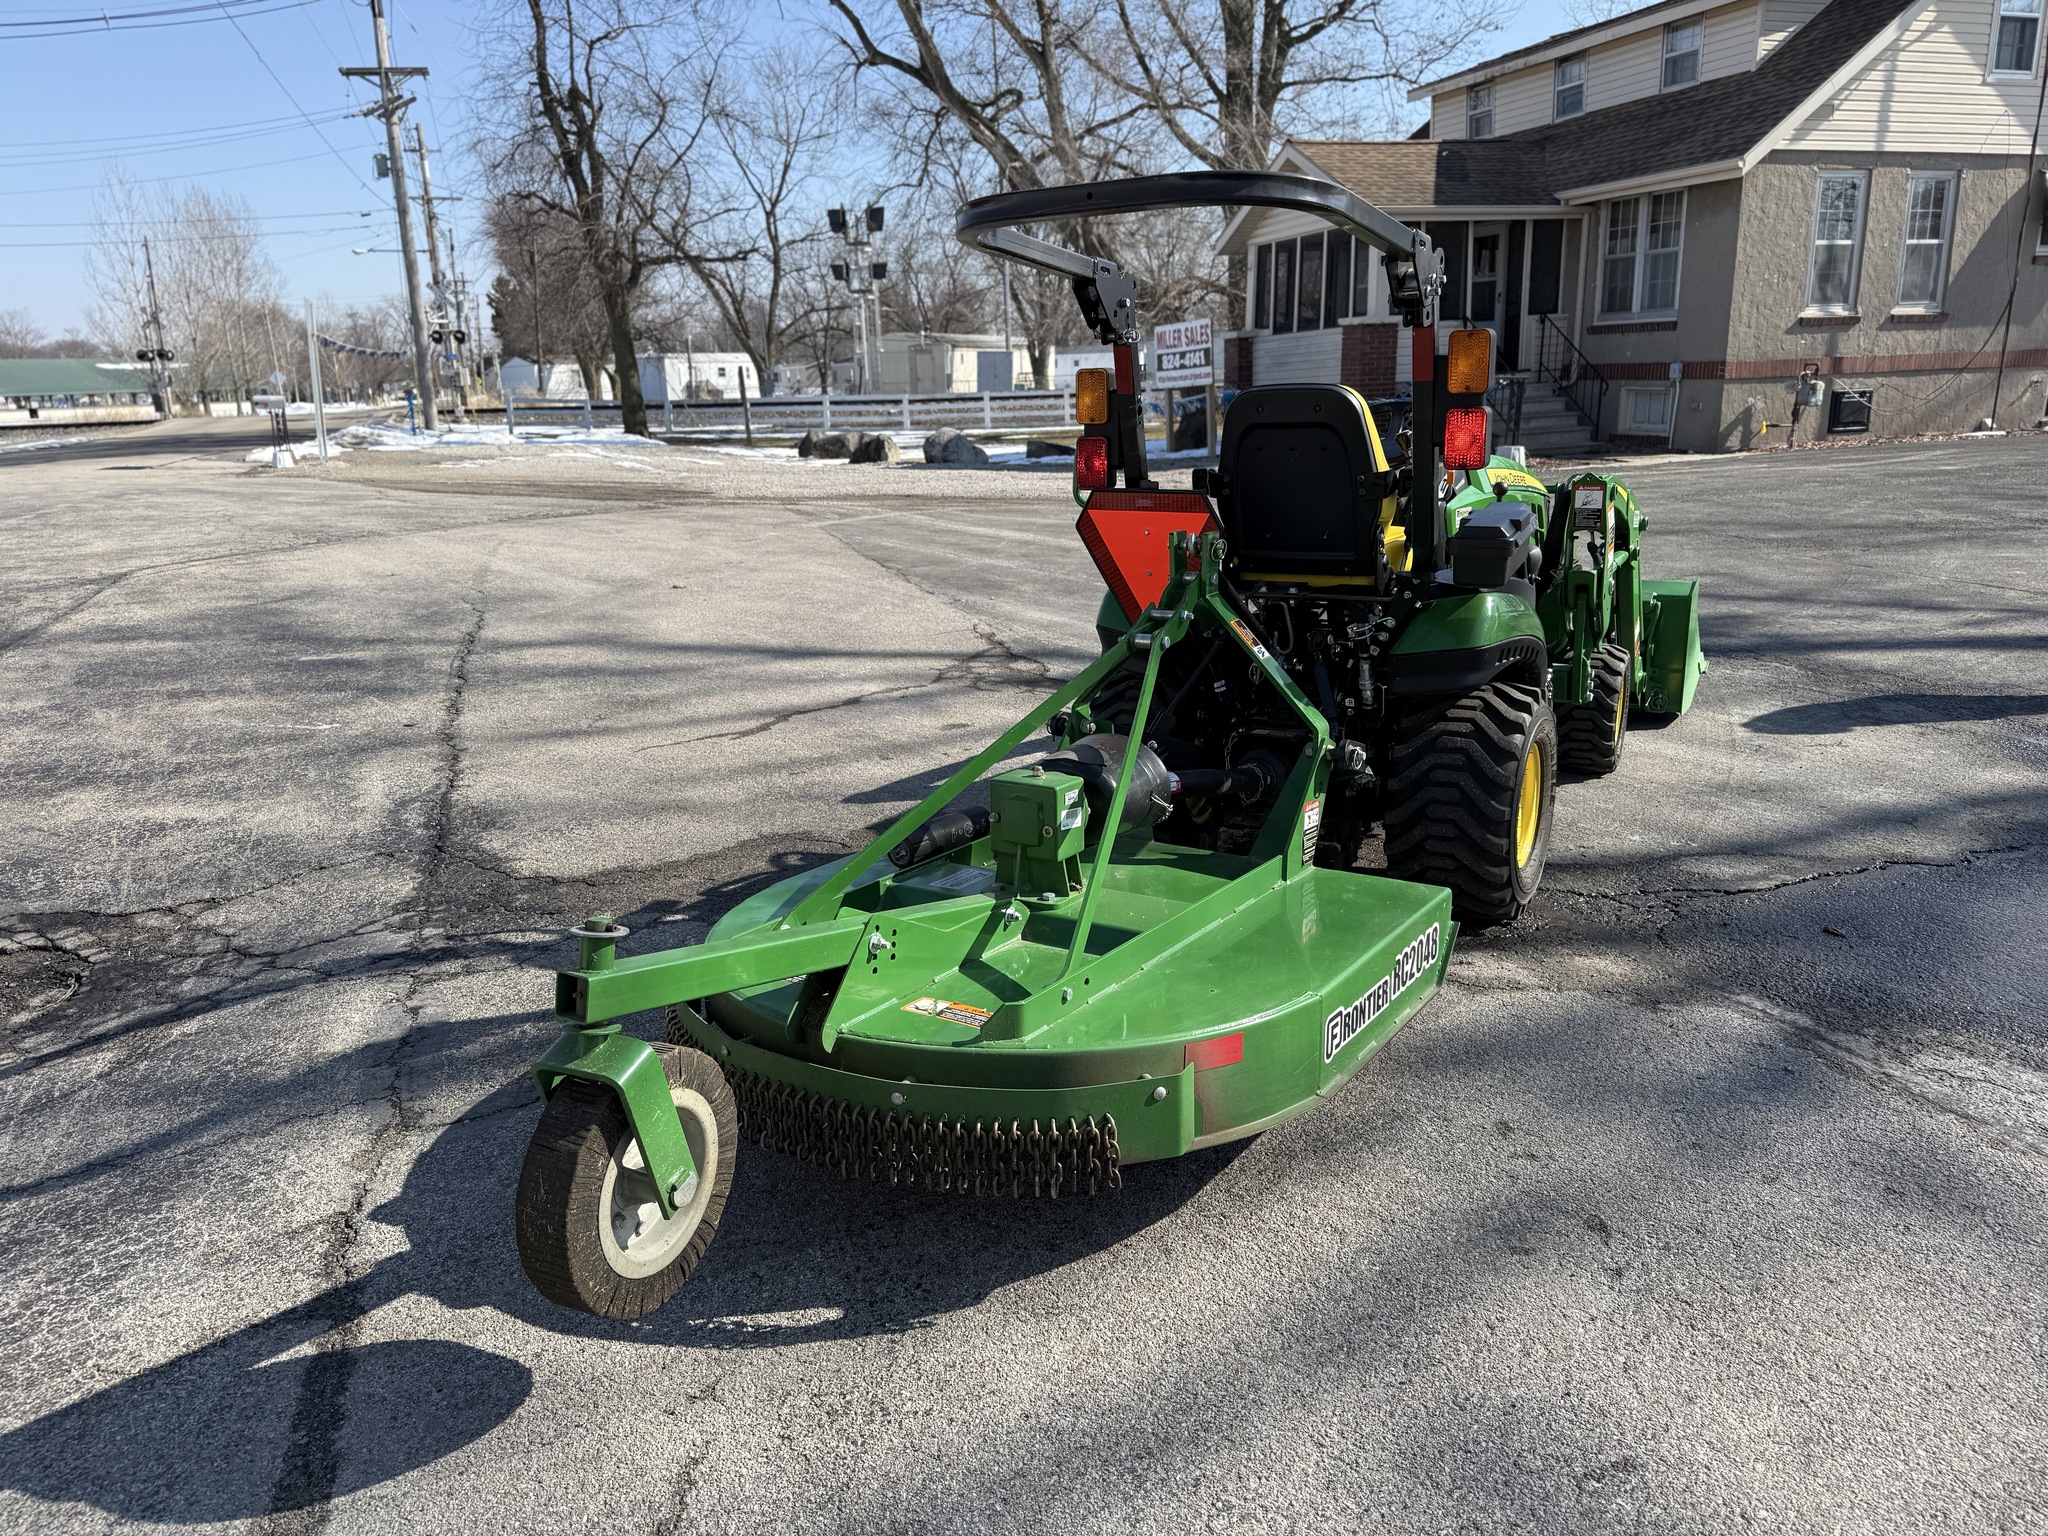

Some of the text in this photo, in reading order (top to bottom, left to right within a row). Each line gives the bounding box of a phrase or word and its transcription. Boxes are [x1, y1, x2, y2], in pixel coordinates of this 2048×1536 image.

[1156, 323, 1210, 350] MILLER SALES
[1162, 350, 1205, 369] 824-4141
[1494, 472, 1527, 485] JOHN DEERE
[1326, 925, 1438, 1061] FRONTIER RC2048
